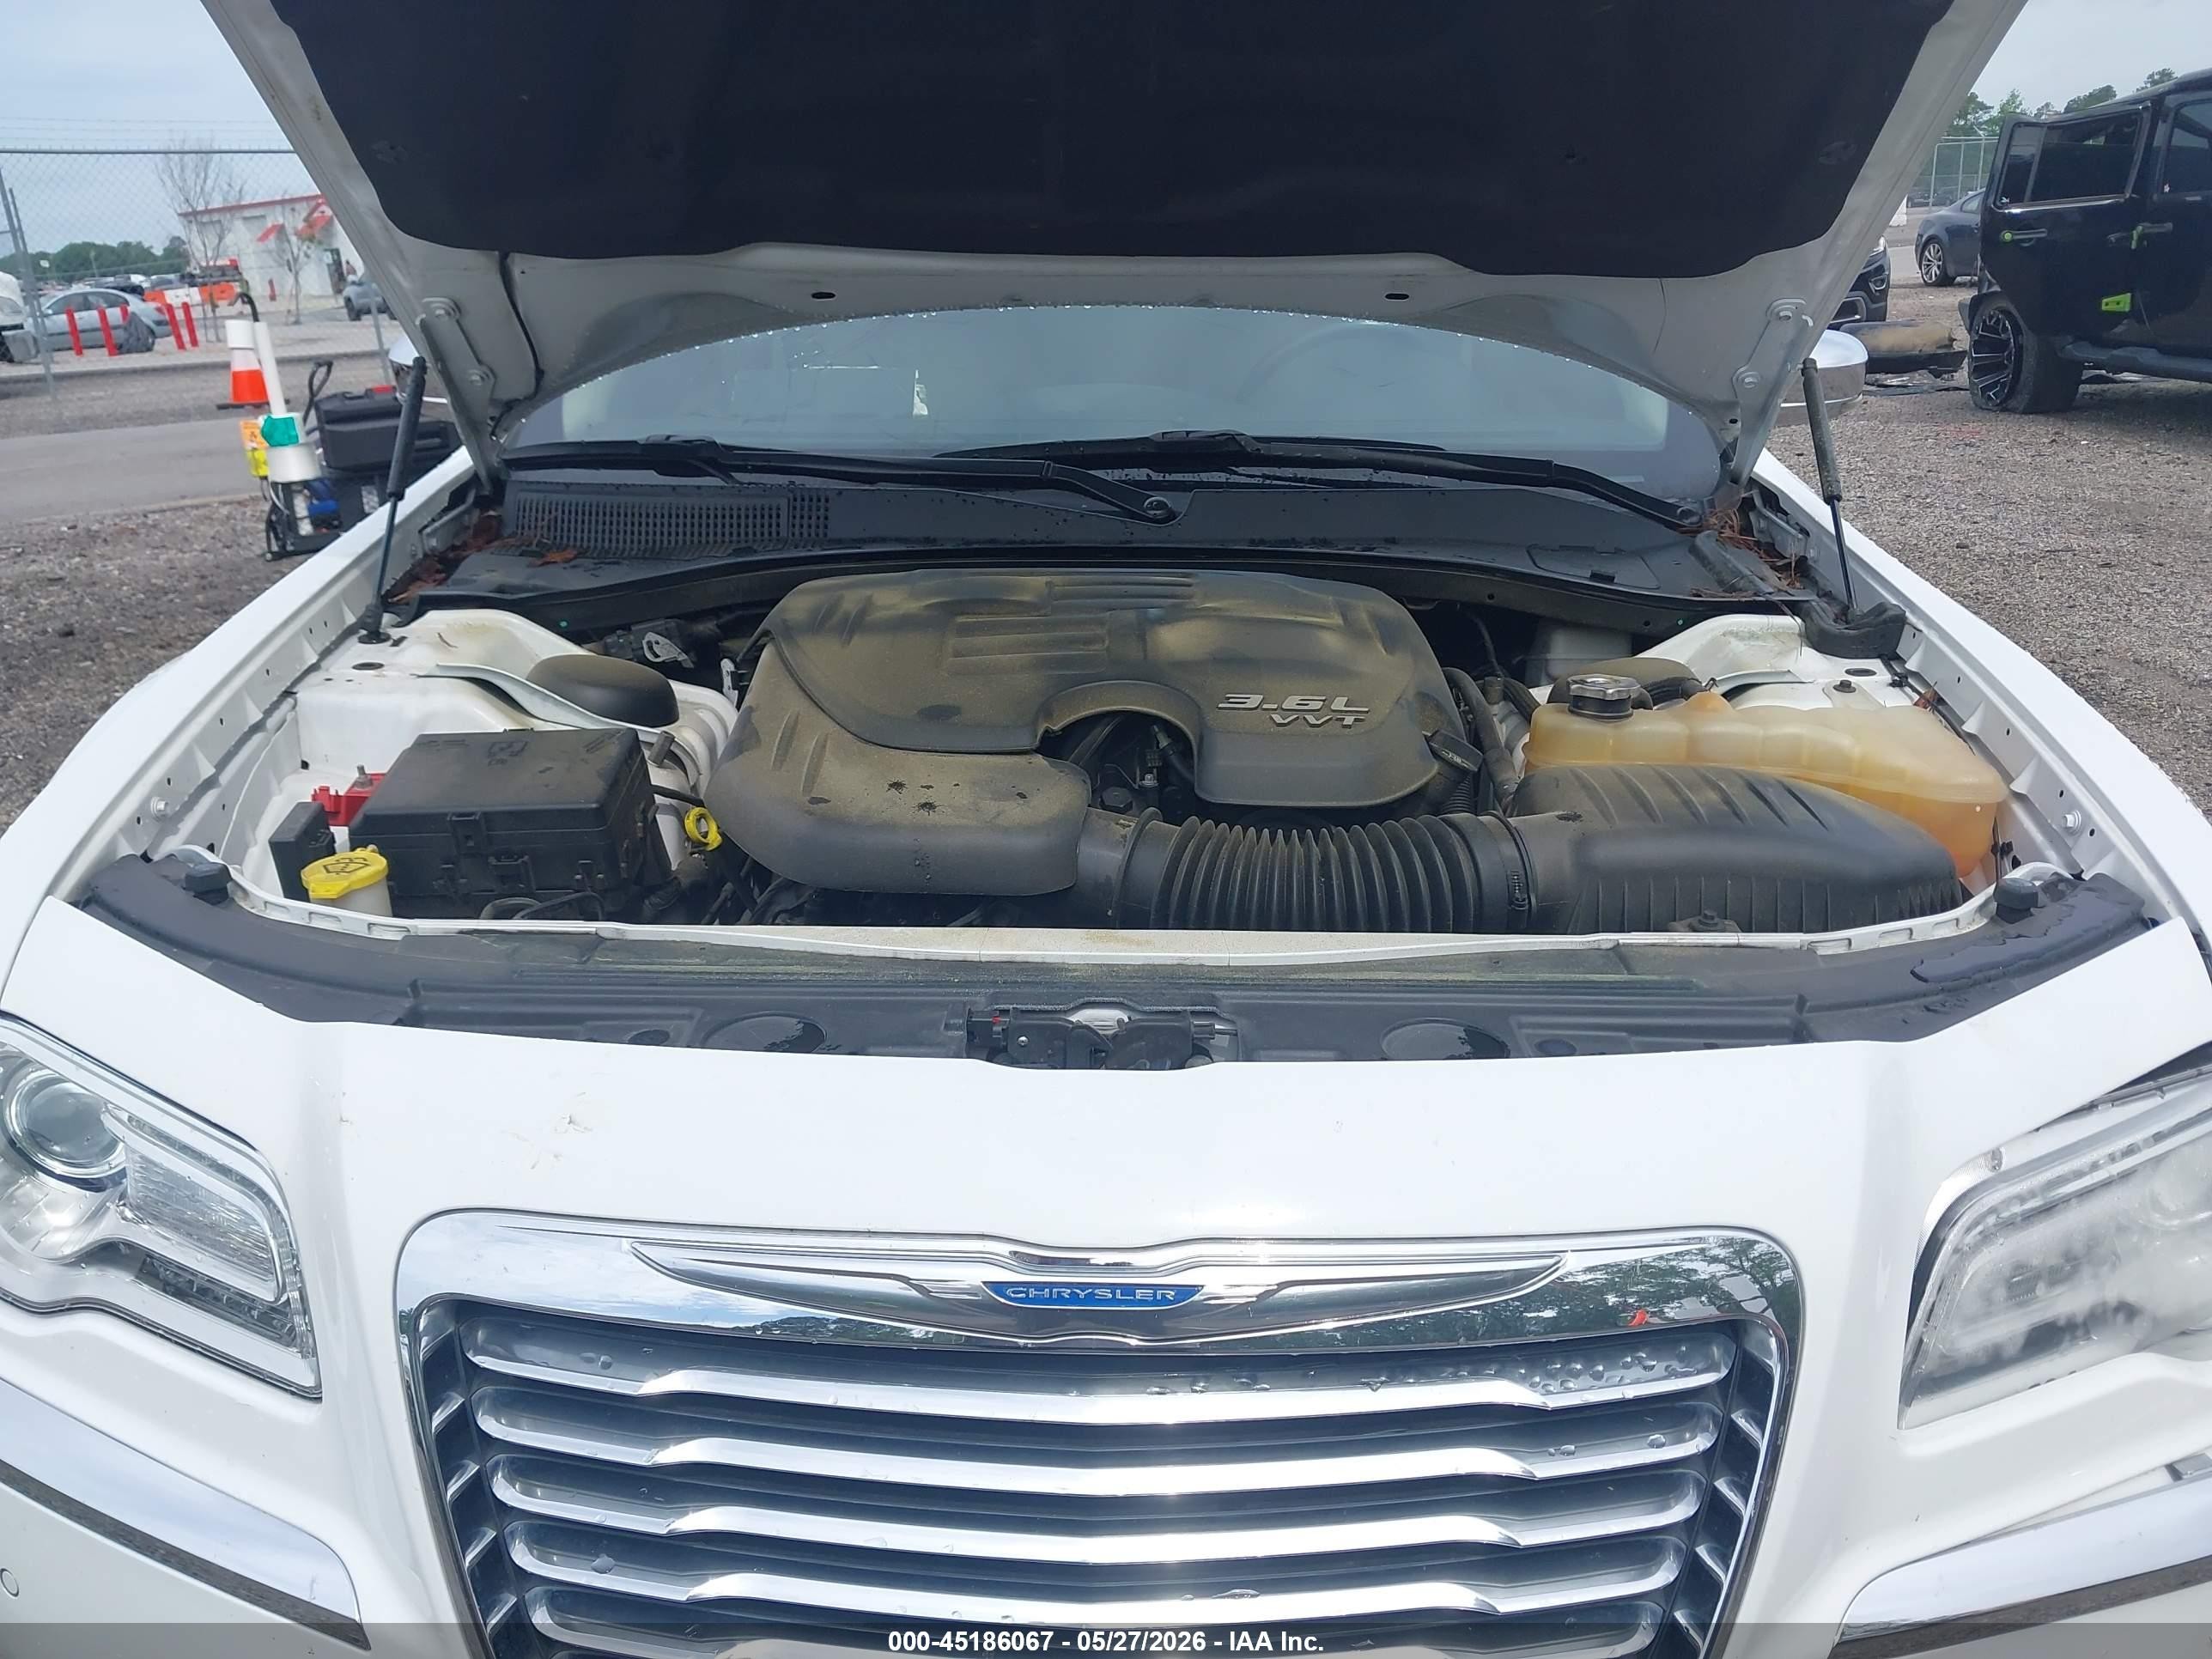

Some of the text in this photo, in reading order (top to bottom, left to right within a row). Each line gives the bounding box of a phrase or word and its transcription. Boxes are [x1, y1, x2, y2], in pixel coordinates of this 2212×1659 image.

[1217, 693, 1370, 714] 3.6L
[1270, 714, 1365, 729] VVT
[1006, 1286, 1176, 1301] CHRYSLER
